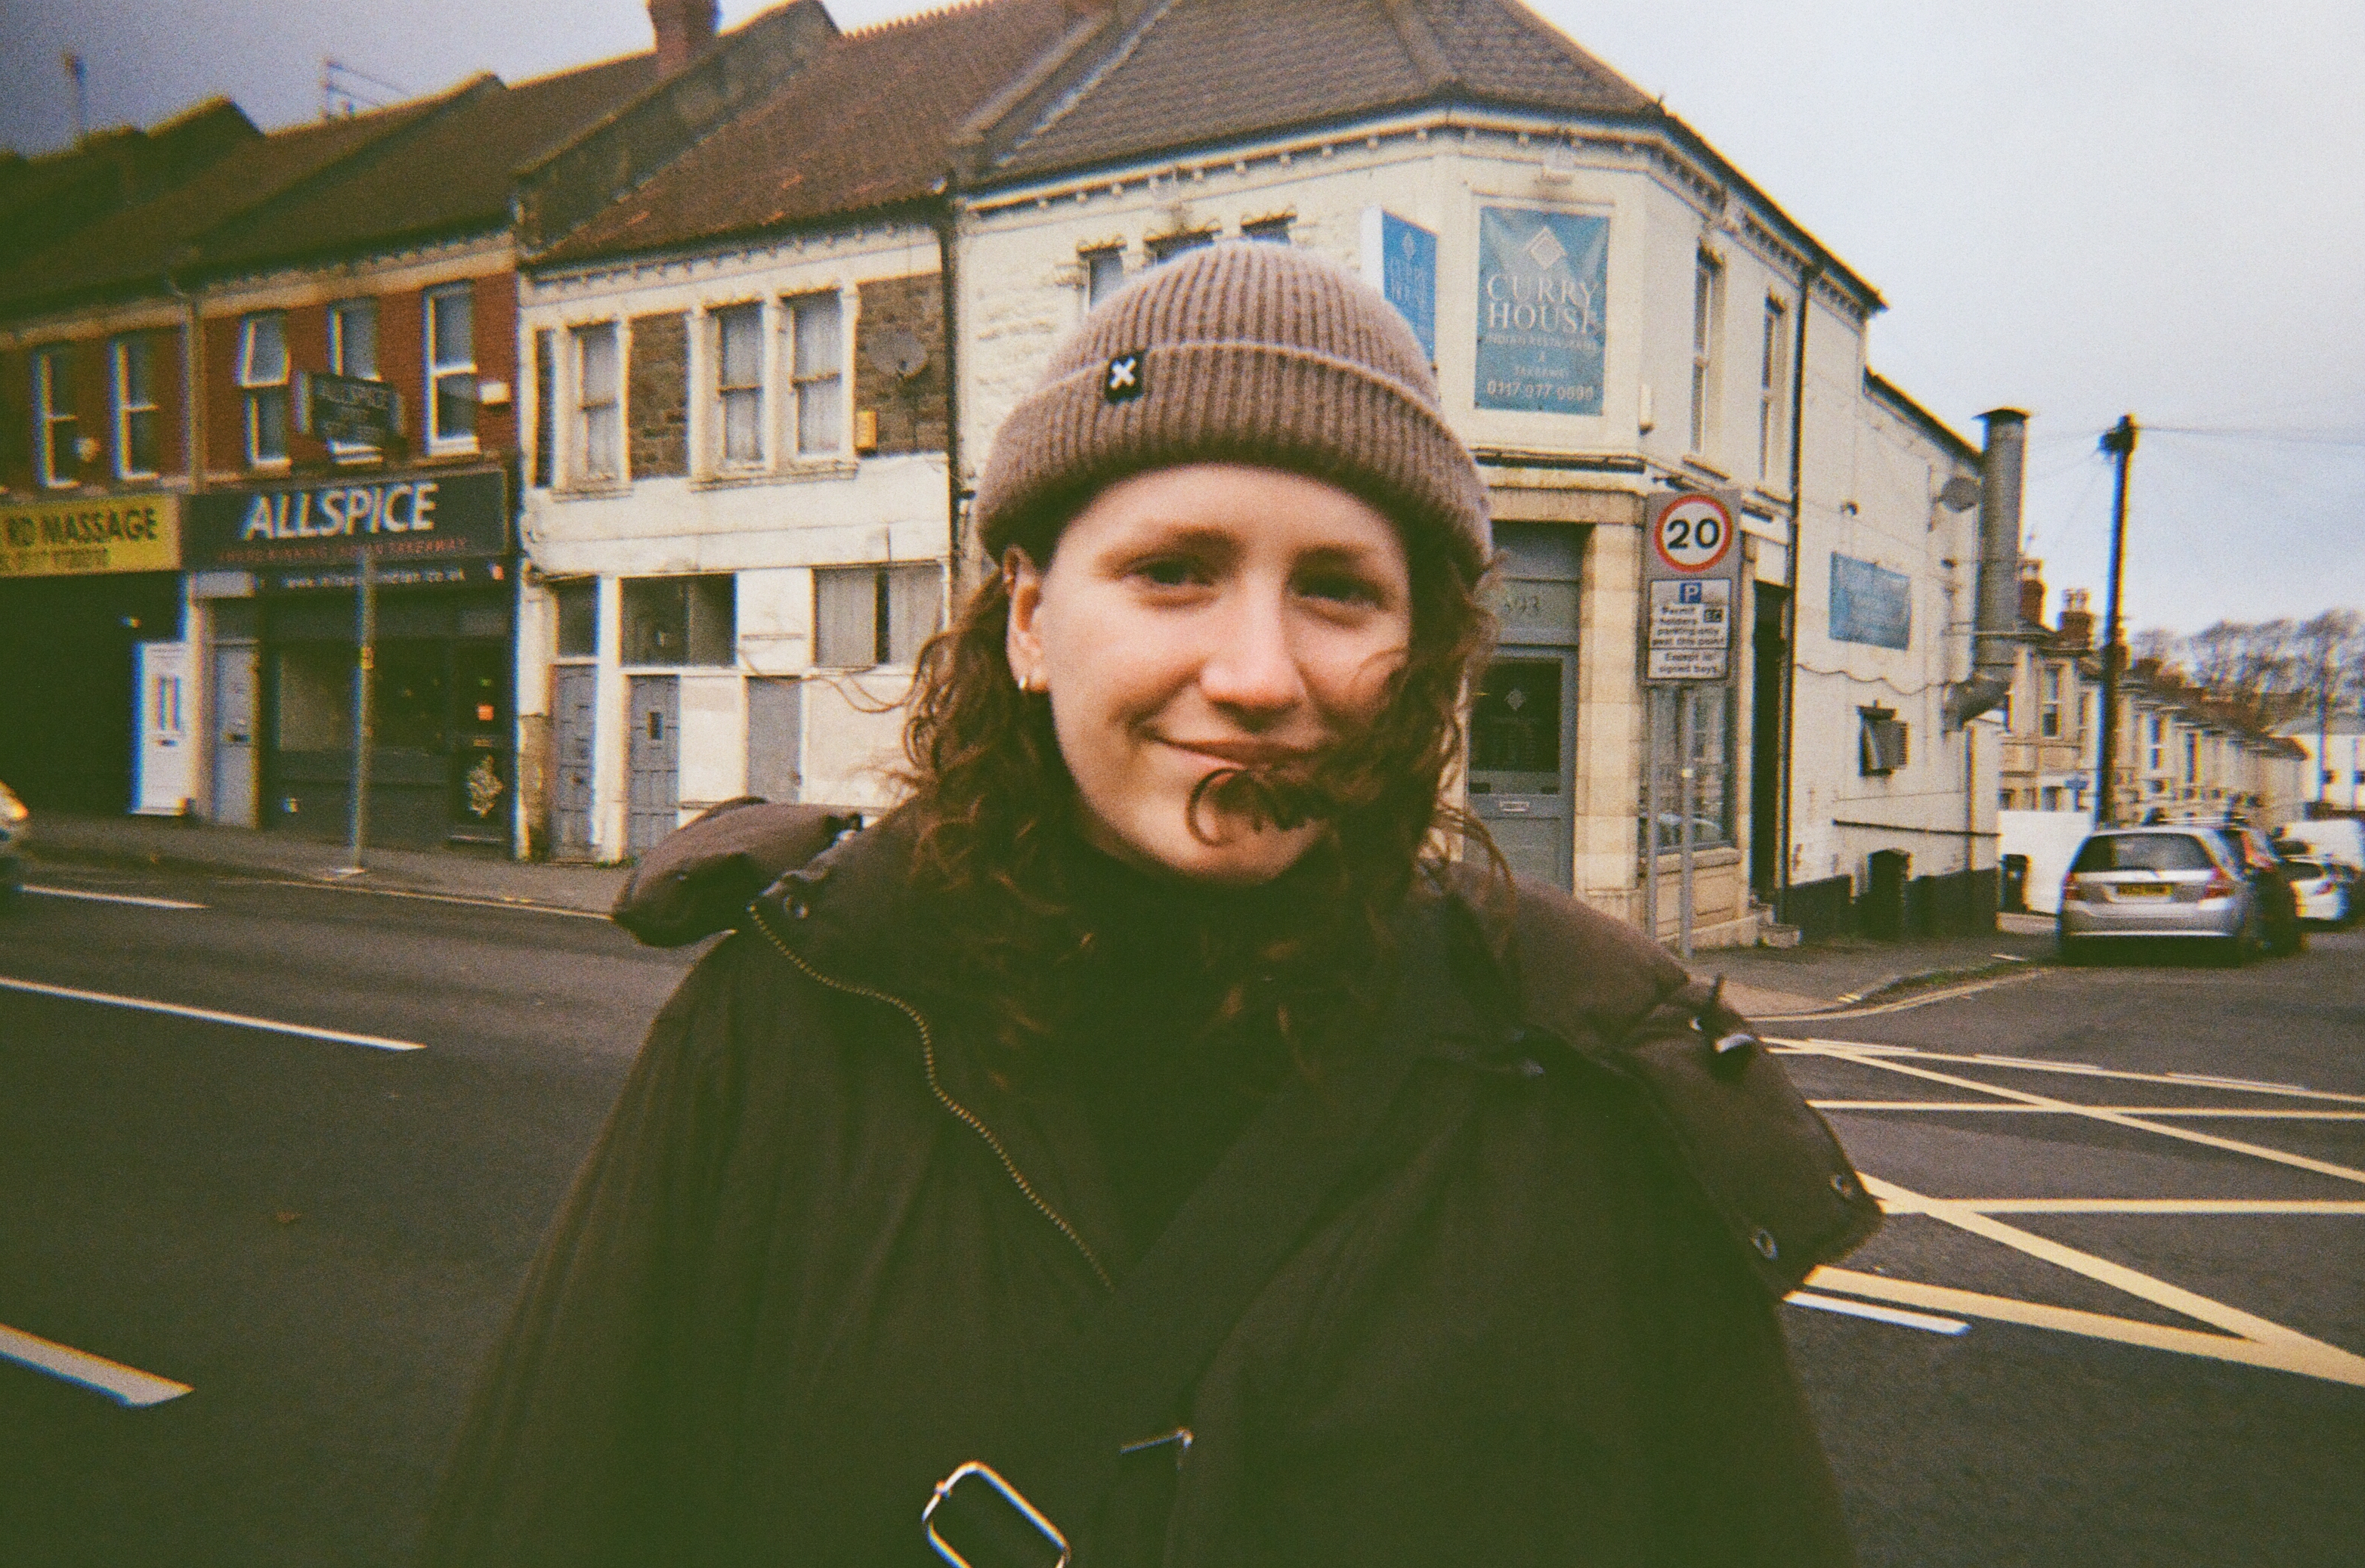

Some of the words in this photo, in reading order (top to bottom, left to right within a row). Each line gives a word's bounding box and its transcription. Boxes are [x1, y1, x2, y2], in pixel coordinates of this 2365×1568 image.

[1486, 273, 1599, 308] CURRY
[1488, 302, 1600, 336] HOUSE
[1487, 380, 1521, 397] 0117
[240, 481, 440, 541] ALLSPICE
[40, 507, 158, 545] MASSAGE
[1667, 518, 1721, 550] 20
[1684, 584, 1699, 603] P
[1661, 606, 1696, 614] Permit
[1656, 628, 1695, 636] parking
[1697, 628, 1719, 636] only
[1698, 637, 1724, 646] point
[1664, 652, 1699, 661] Except
[1658, 665, 1690, 674] signed
[1693, 664, 1717, 675] bays
